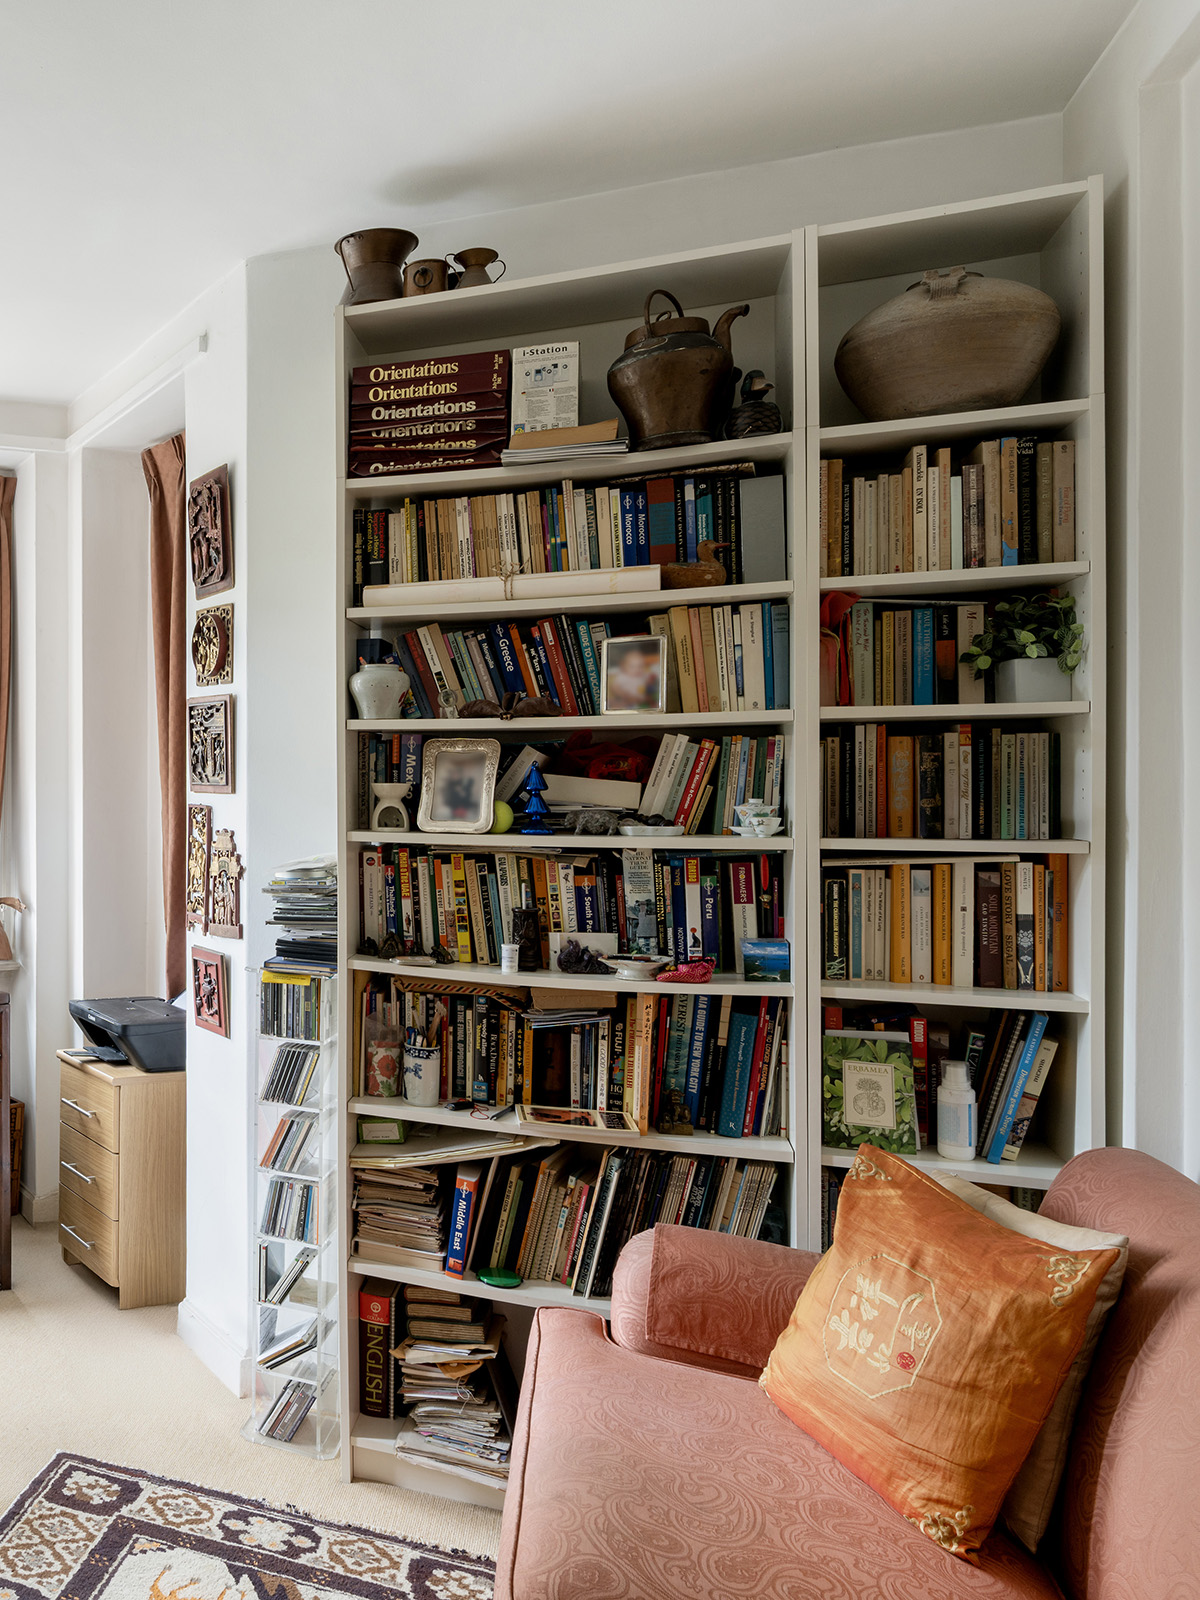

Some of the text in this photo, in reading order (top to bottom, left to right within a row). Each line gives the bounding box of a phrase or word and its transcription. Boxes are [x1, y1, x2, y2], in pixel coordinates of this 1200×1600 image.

[370, 361, 458, 382] Orientations
[369, 381, 458, 401] Orientations
[372, 401, 476, 420] Orientations
[1021, 458, 1031, 552] MYRA BRECKINRIDGE
[1063, 505, 1071, 523] Flying
[579, 625, 589, 647] GUIDE
[482, 643, 494, 668] Mongolia
[500, 638, 514, 672] Greece
[538, 646, 547, 664] Lisbon
[584, 648, 592, 658] TO
[587, 658, 595, 671] THE
[700, 749, 709, 761] Hong
[690, 774, 700, 789] Macau
[684, 794, 693, 809] Canton
[401, 883, 410, 896] UAE
[738, 867, 747, 902] FROMMER'S
[1004, 870, 1012, 893] LOVE
[482, 885, 492, 927] BHUTAN
[656, 897, 664, 921] CHINA
[1056, 902, 1064, 922] India
[989, 894, 998, 955] SOUL MOUNTAIN
[698, 996, 708, 1008] AIA
[676, 994, 688, 1034] EVEREST
[695, 1010, 706, 1030] GUIDE
[1034, 1021, 1042, 1036] BOBBY
[614, 1031, 622, 1052] FUJI
[692, 1041, 702, 1057] NEW
[763, 1044, 772, 1063] LONGER
[690, 1059, 701, 1076] YORK
[760, 1064, 769, 1091] MEDIAEVAL
[848, 1064, 889, 1075] ERBAMEA
[1034, 1059, 1045, 1083] SHANGHAI
[611, 1085, 623, 1093] HQ
[688, 1077, 698, 1094] CITY
[689, 1185, 698, 1204] ATLAS
[694, 1186, 704, 1207] TRAVEL
[453, 1199, 466, 1250] Middle East
[580, 1165, 614, 1284] WILD FLOWERS OF HONG KONG
[366, 1324, 383, 1403] ENGLISH
